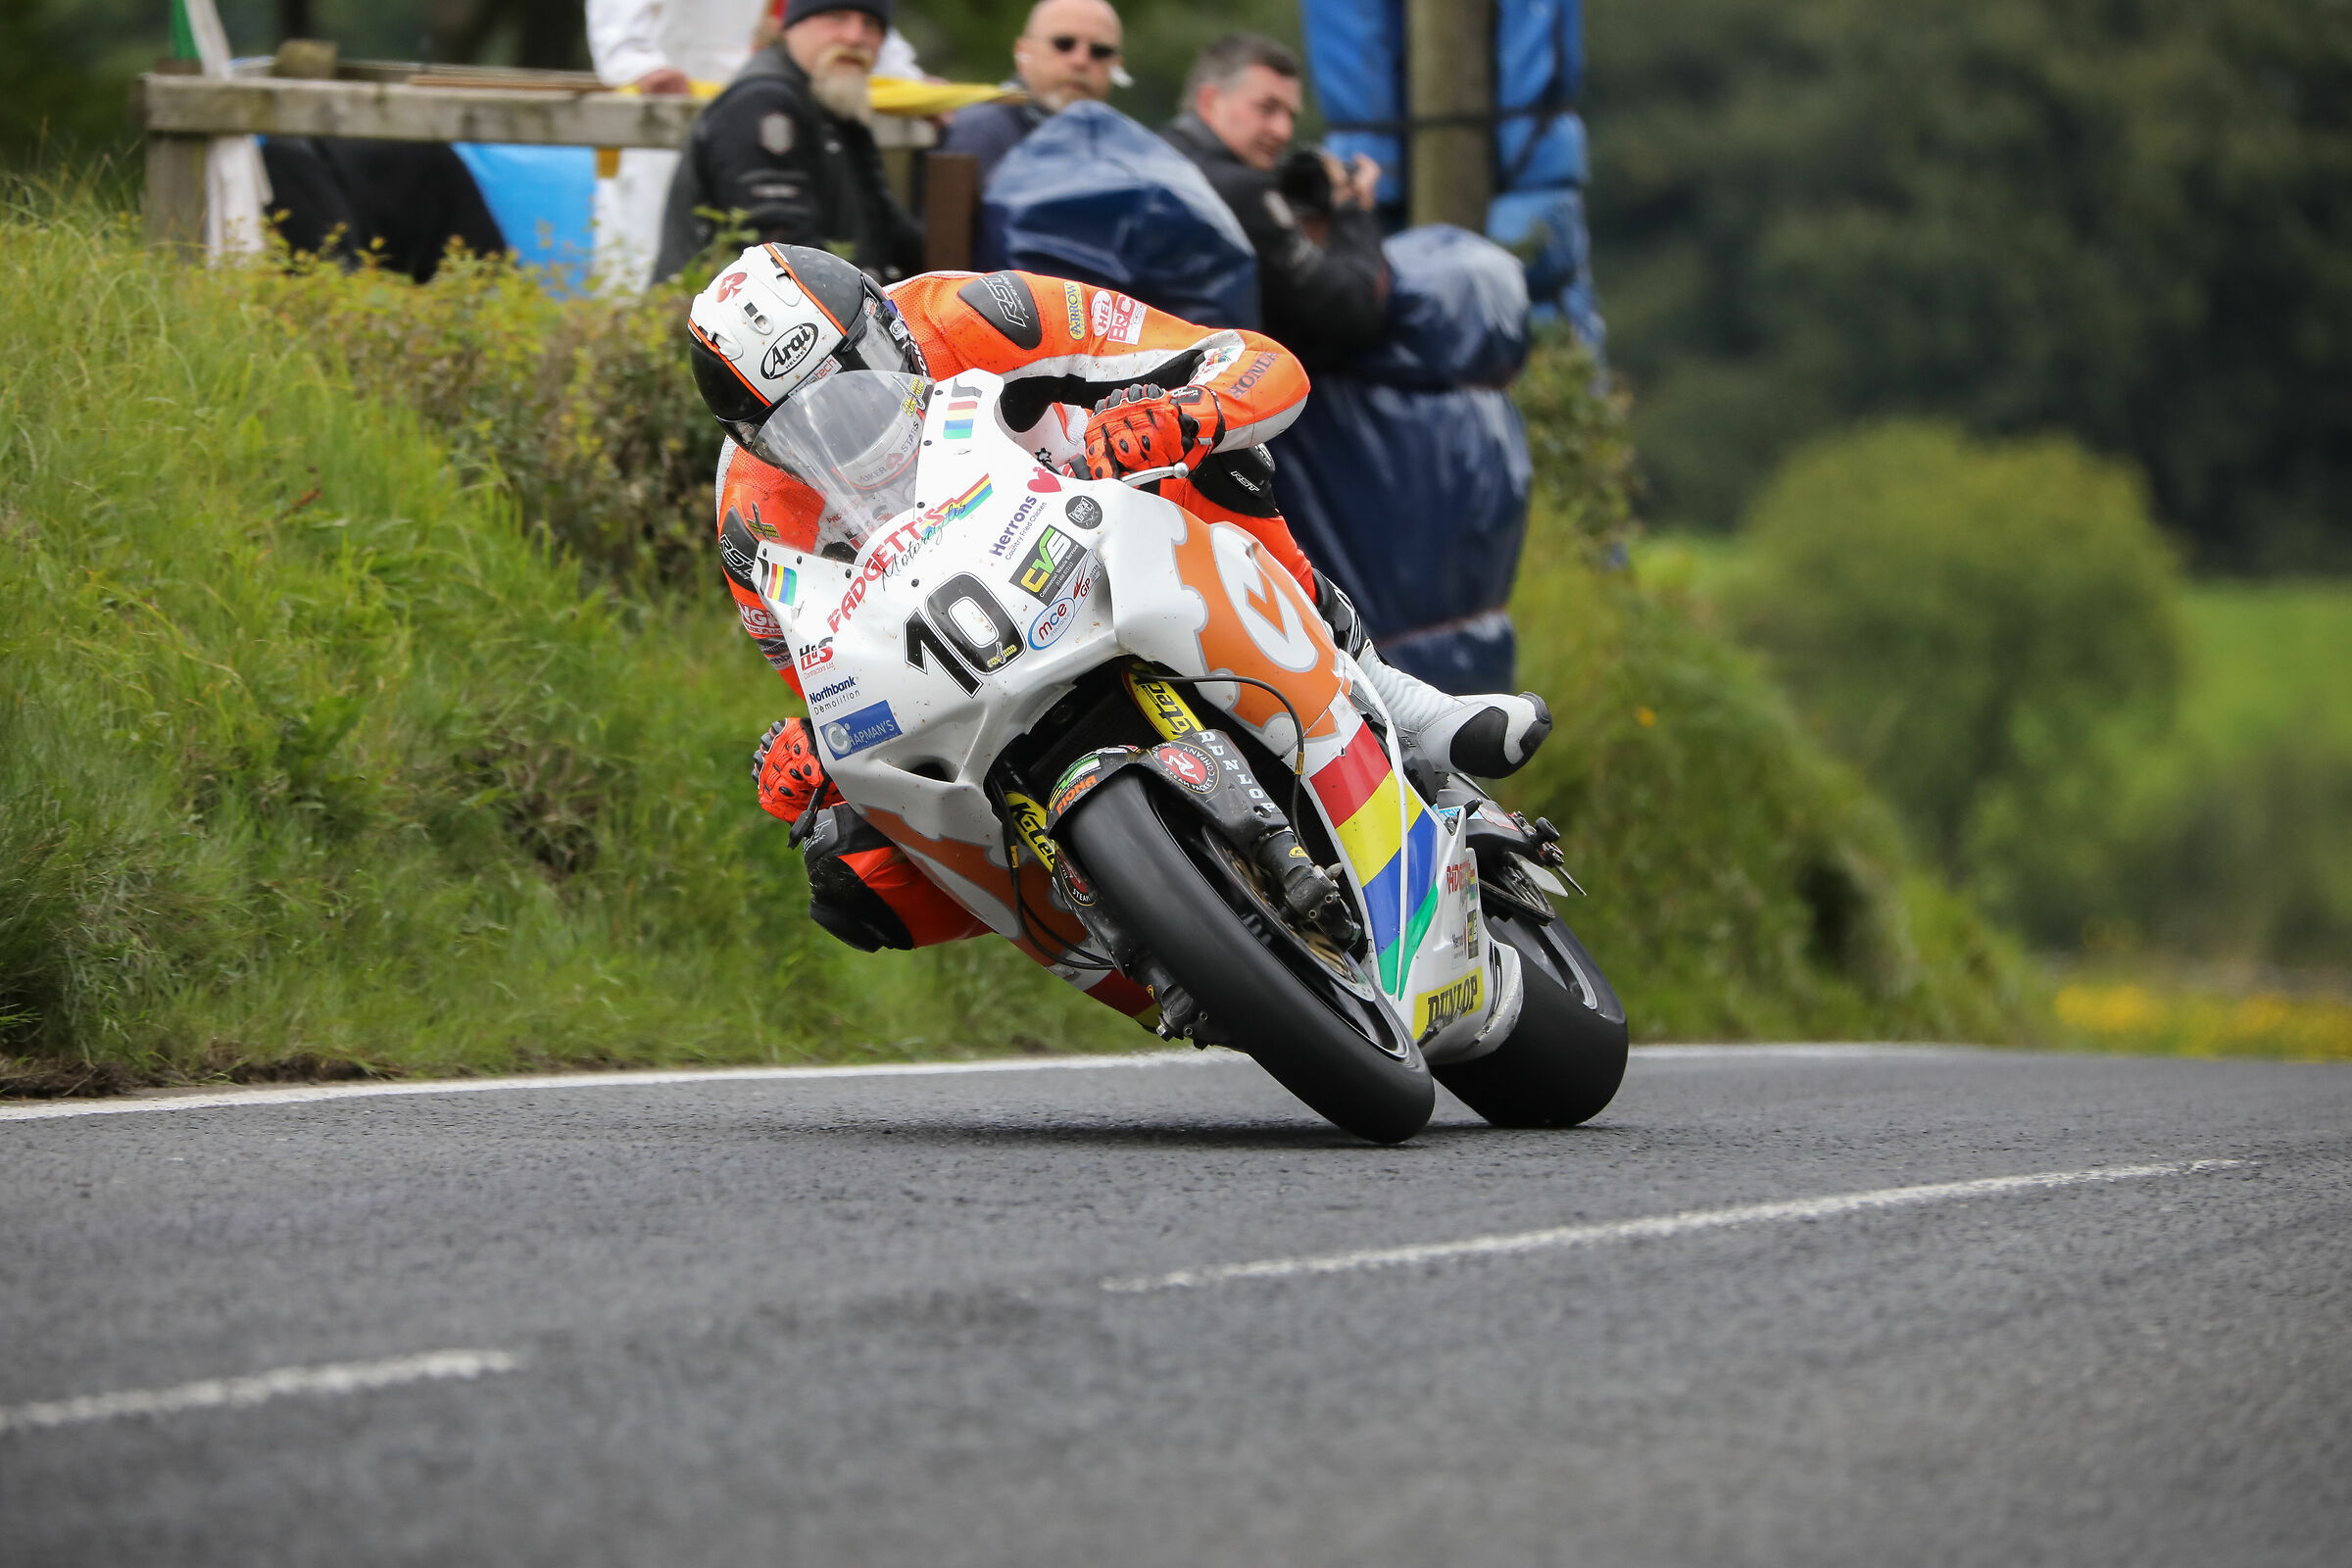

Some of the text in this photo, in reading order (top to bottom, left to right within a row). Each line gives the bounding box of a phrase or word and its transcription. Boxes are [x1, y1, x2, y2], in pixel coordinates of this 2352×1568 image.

[1065, 283, 1082, 335] ARROW
[1098, 300, 1111, 329] HEL
[768, 324, 812, 378] Arai
[785, 348, 808, 369] HELMET
[1227, 351, 1278, 400] HONDA
[989, 495, 1037, 557] Herrons
[1005, 502, 1048, 561] Country Fried Chicken
[826, 507, 947, 634] PADGETT'S
[1080, 578, 1091, 598] GP
[903, 571, 1028, 699] 10
[1039, 603, 1067, 641] mce
[808, 675, 857, 705] Northbank
[813, 689, 860, 715] Demolition
[1183, 746, 1216, 777] COMPANY
[1198, 731, 1275, 816] DUNLOP
[1056, 774, 1098, 815] FIONA
[1427, 975, 1478, 1027] DUNLOP
